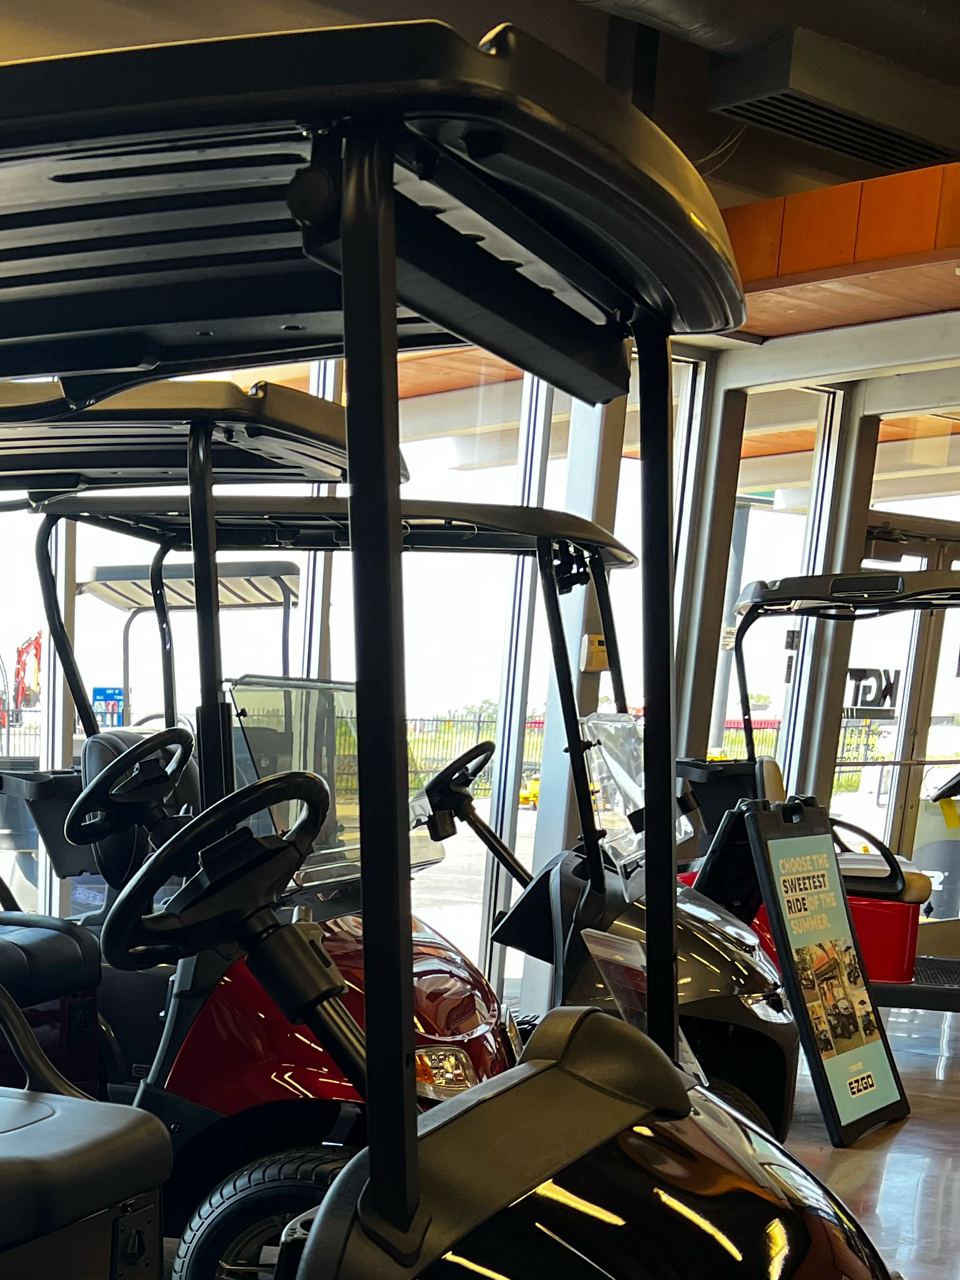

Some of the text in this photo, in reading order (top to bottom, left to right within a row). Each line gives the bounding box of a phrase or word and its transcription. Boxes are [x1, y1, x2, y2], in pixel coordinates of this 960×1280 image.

[779, 853, 830, 874] CHOOSE THE
[782, 874, 827, 895] SWEETEST
[786, 892, 837, 915] RIDE OF THE
[790, 914, 831, 935] SUMMER.
